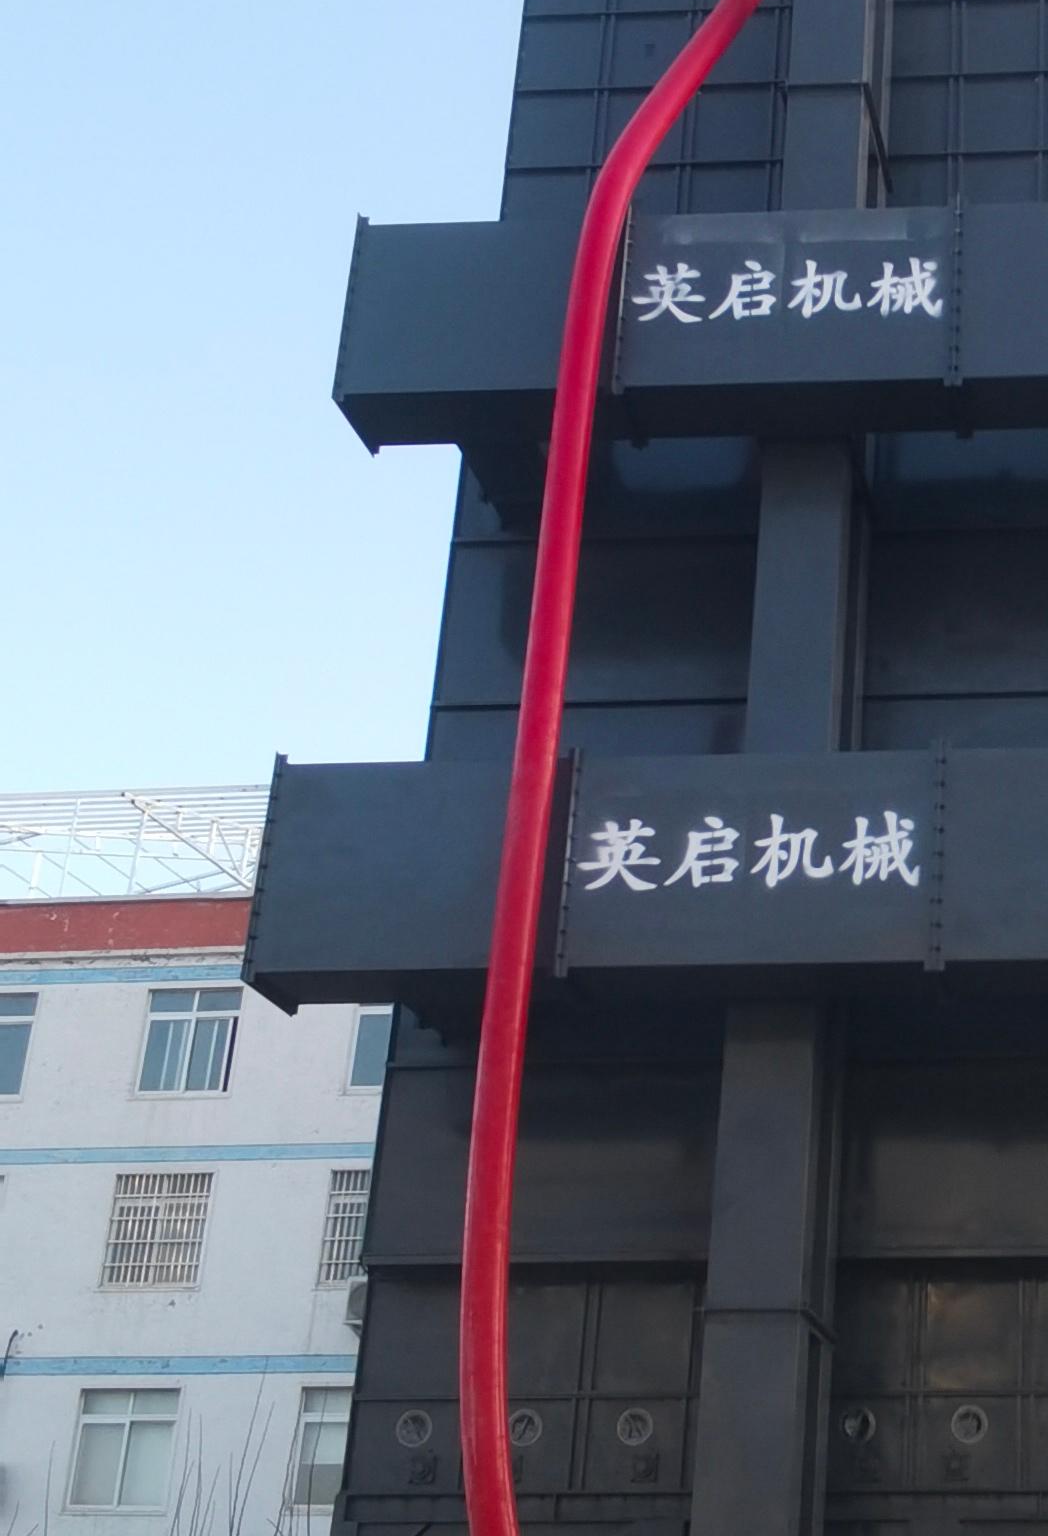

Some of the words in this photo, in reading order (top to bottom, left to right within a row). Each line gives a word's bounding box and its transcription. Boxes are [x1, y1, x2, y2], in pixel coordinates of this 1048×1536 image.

[631, 257, 943, 324] 英启机械
[577, 810, 920, 891] 英启机械
